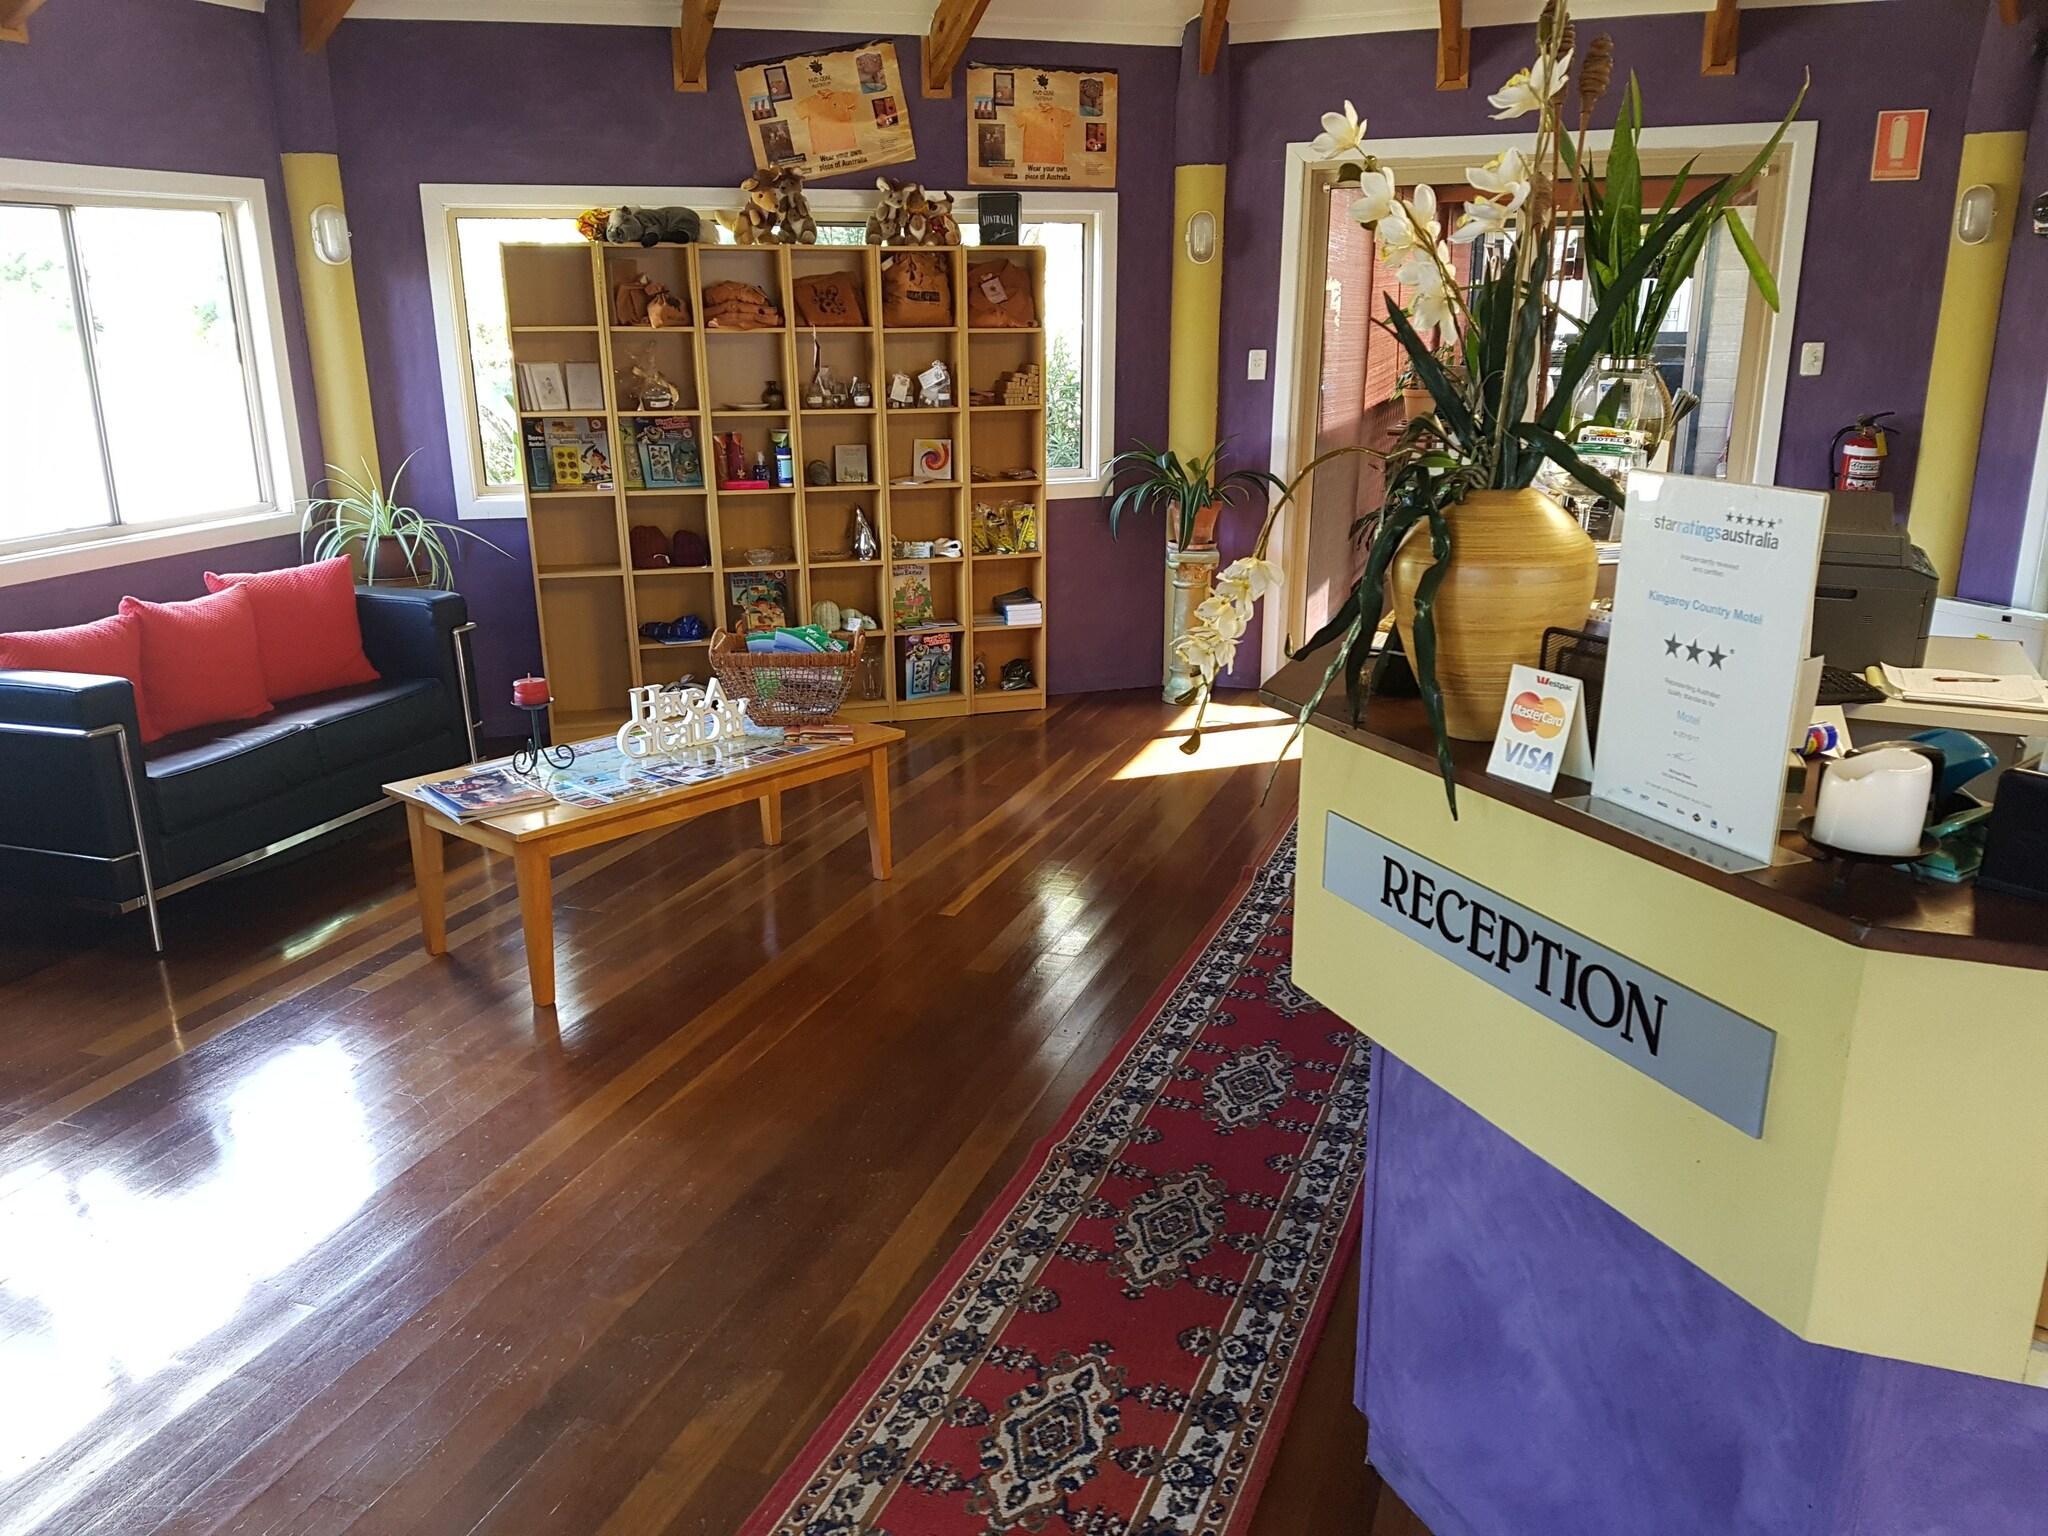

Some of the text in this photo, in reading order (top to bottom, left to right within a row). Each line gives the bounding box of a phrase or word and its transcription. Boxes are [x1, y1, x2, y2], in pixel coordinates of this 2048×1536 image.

[820, 154, 834, 162] Wear
[842, 156, 868, 167] Australia
[1046, 173, 1071, 181] Australia
[982, 213, 1014, 227] AUSTRALIA
[1648, 589, 1764, 625] Kingaroy Country Motel
[1536, 675, 1574, 691] Westpac
[1511, 703, 1564, 727] MasterCard
[1504, 736, 1554, 775] VISA
[1380, 855, 1668, 1056] RECEPTION
